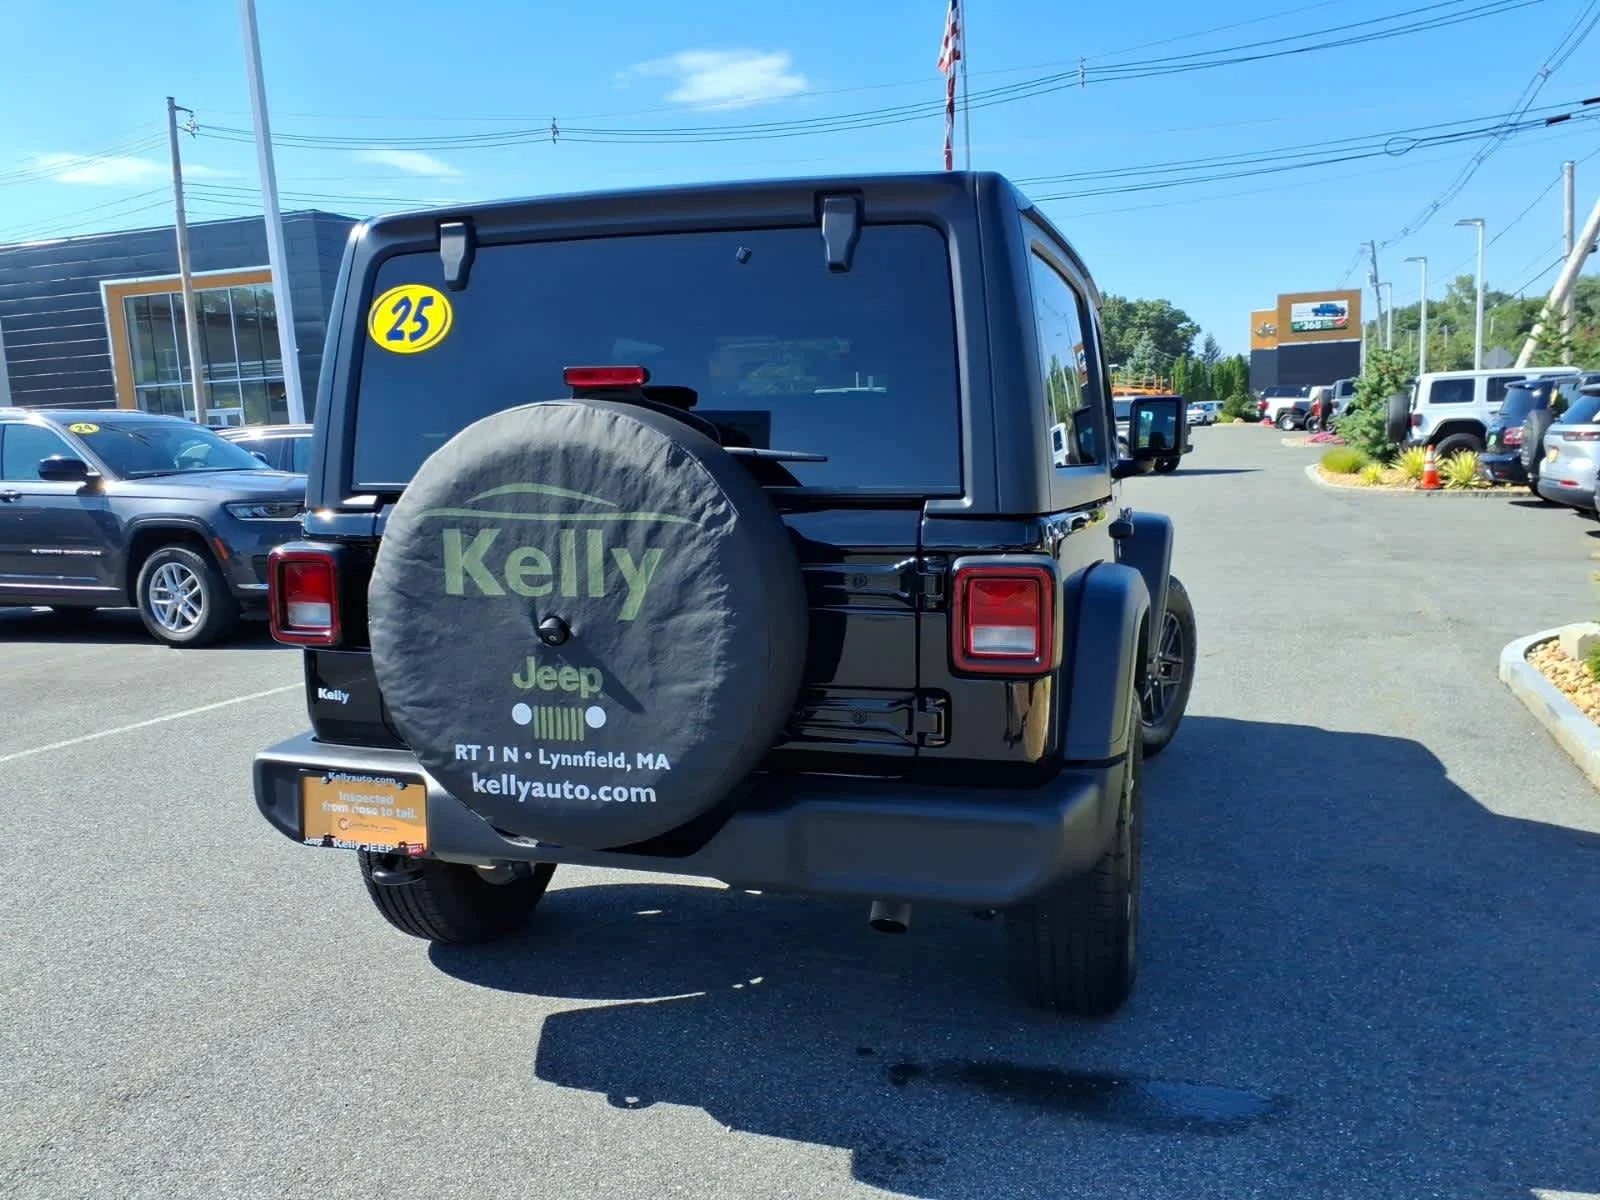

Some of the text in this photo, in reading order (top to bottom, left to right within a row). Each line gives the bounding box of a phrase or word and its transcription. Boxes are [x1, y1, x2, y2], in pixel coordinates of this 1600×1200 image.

[386, 295, 434, 343] 25
[442, 528, 664, 621] Kelly
[512, 656, 604, 698] Jeep
[317, 687, 350, 704] Kelly
[455, 744, 671, 772] RT 1 N Lynnfield, MA
[328, 772, 396, 783] Kellyauto.com
[471, 772, 657, 802] kellyauto.com
[322, 801, 349, 813] from
[381, 806, 393, 817] to
[338, 791, 394, 805] Inspected
[333, 838, 361, 850] Kelly
[362, 841, 393, 853] JEEP
